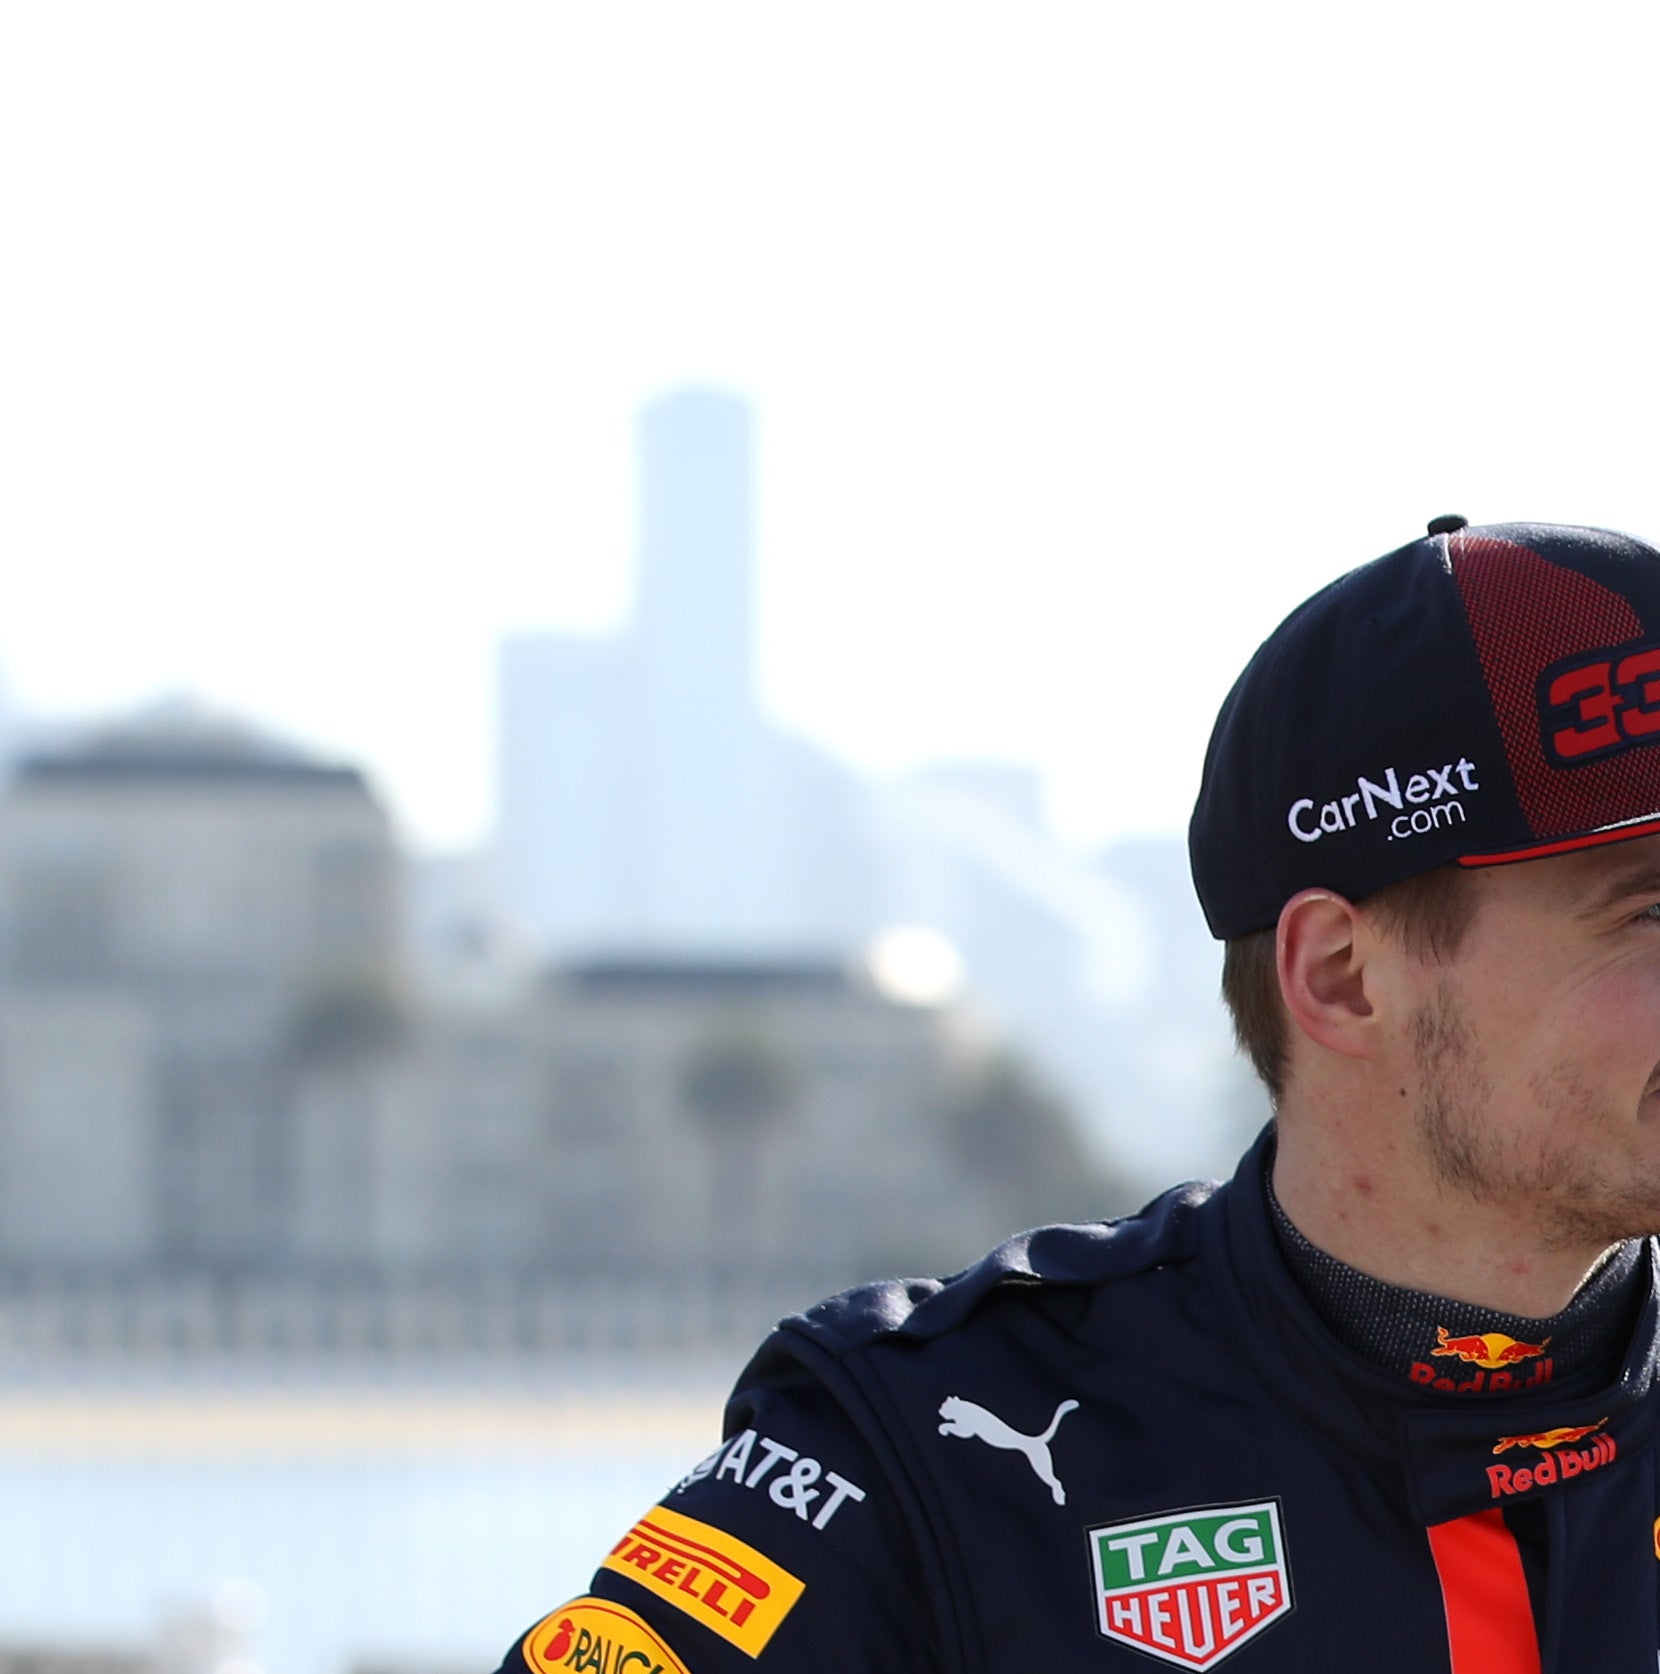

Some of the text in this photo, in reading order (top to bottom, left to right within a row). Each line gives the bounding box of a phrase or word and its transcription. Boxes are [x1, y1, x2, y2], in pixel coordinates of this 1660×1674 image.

[1288, 757, 1479, 843] CarNext
[1386, 800, 1466, 841] .com
[716, 1429, 866, 1531] AT&T
[1485, 1432, 1617, 1499] Red Bull
[611, 1536, 757, 1628] IRELLI
[1107, 1518, 1264, 1581] TAG
[1111, 1576, 1281, 1658] HEUER
